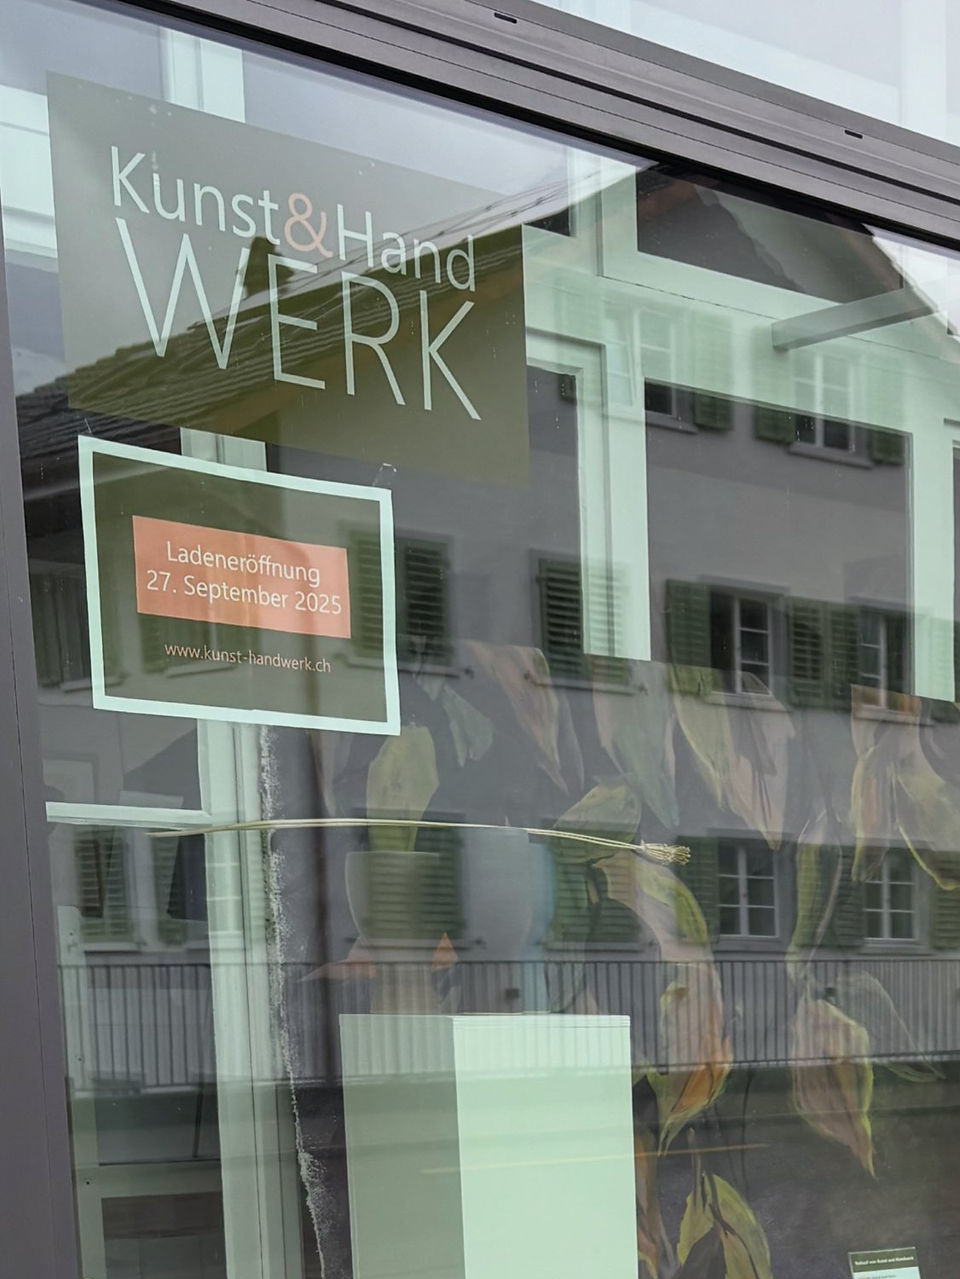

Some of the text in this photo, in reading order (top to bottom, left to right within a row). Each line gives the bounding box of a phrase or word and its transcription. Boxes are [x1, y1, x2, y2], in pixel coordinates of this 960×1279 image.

[112, 145, 475, 292] Kunst&Hand
[115, 217, 482, 421] WERK
[166, 540, 321, 588] Ladeneröffnung
[146, 569, 343, 615] 27. September 2025
[164, 643, 332, 673] www.kunst-handwerk.ch
